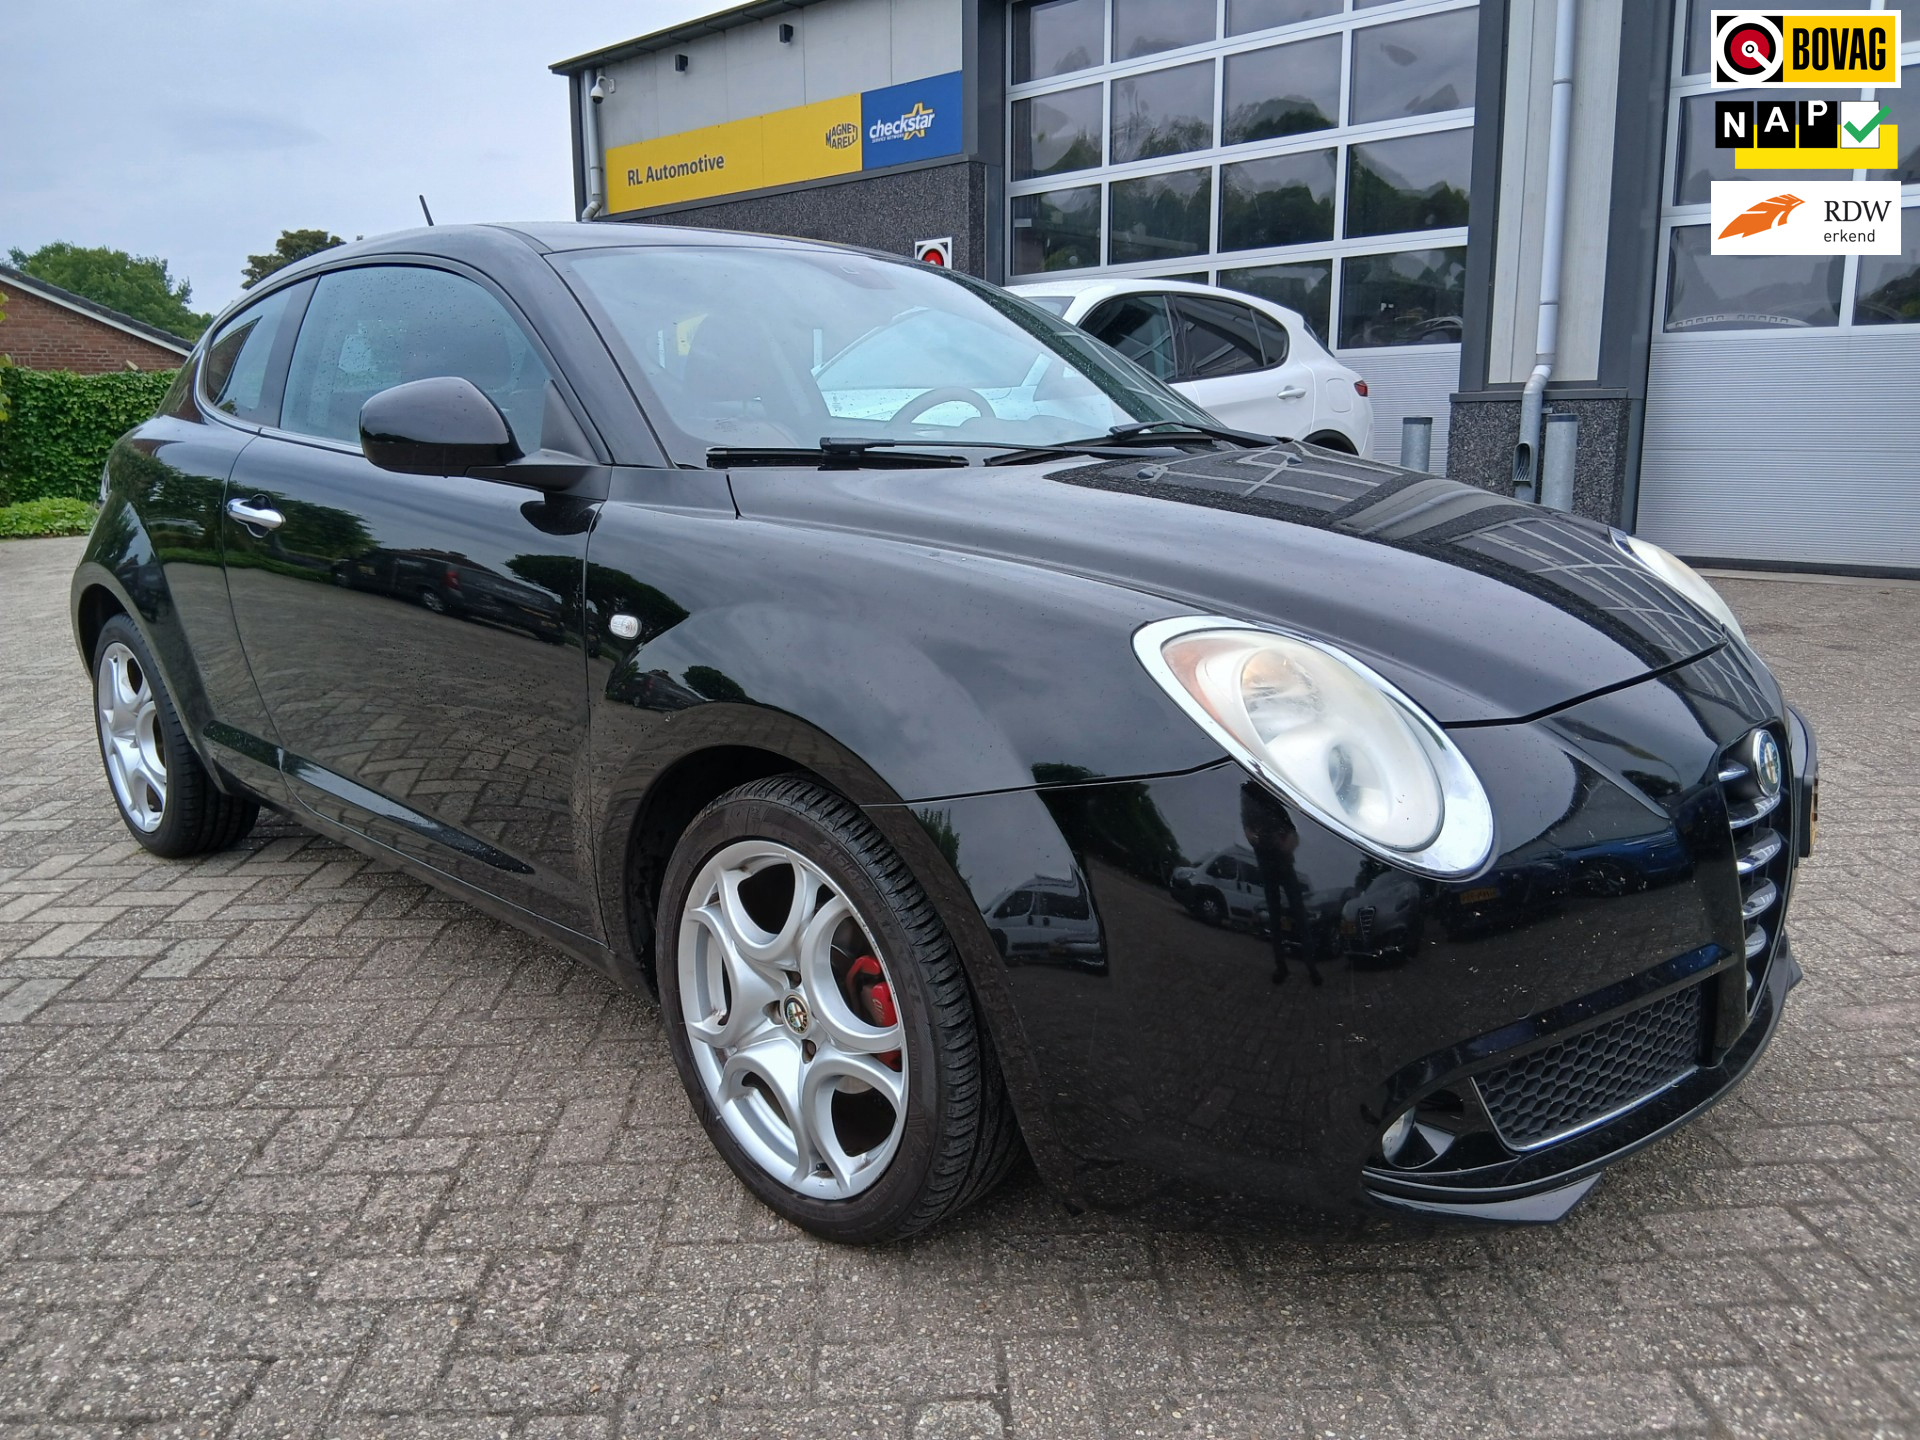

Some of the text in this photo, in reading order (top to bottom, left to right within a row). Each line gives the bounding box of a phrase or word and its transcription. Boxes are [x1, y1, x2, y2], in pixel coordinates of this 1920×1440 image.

[825, 122, 858, 138] MAGNETI
[869, 114, 935, 138] checkstar
[627, 154, 725, 186] RL Automotive
